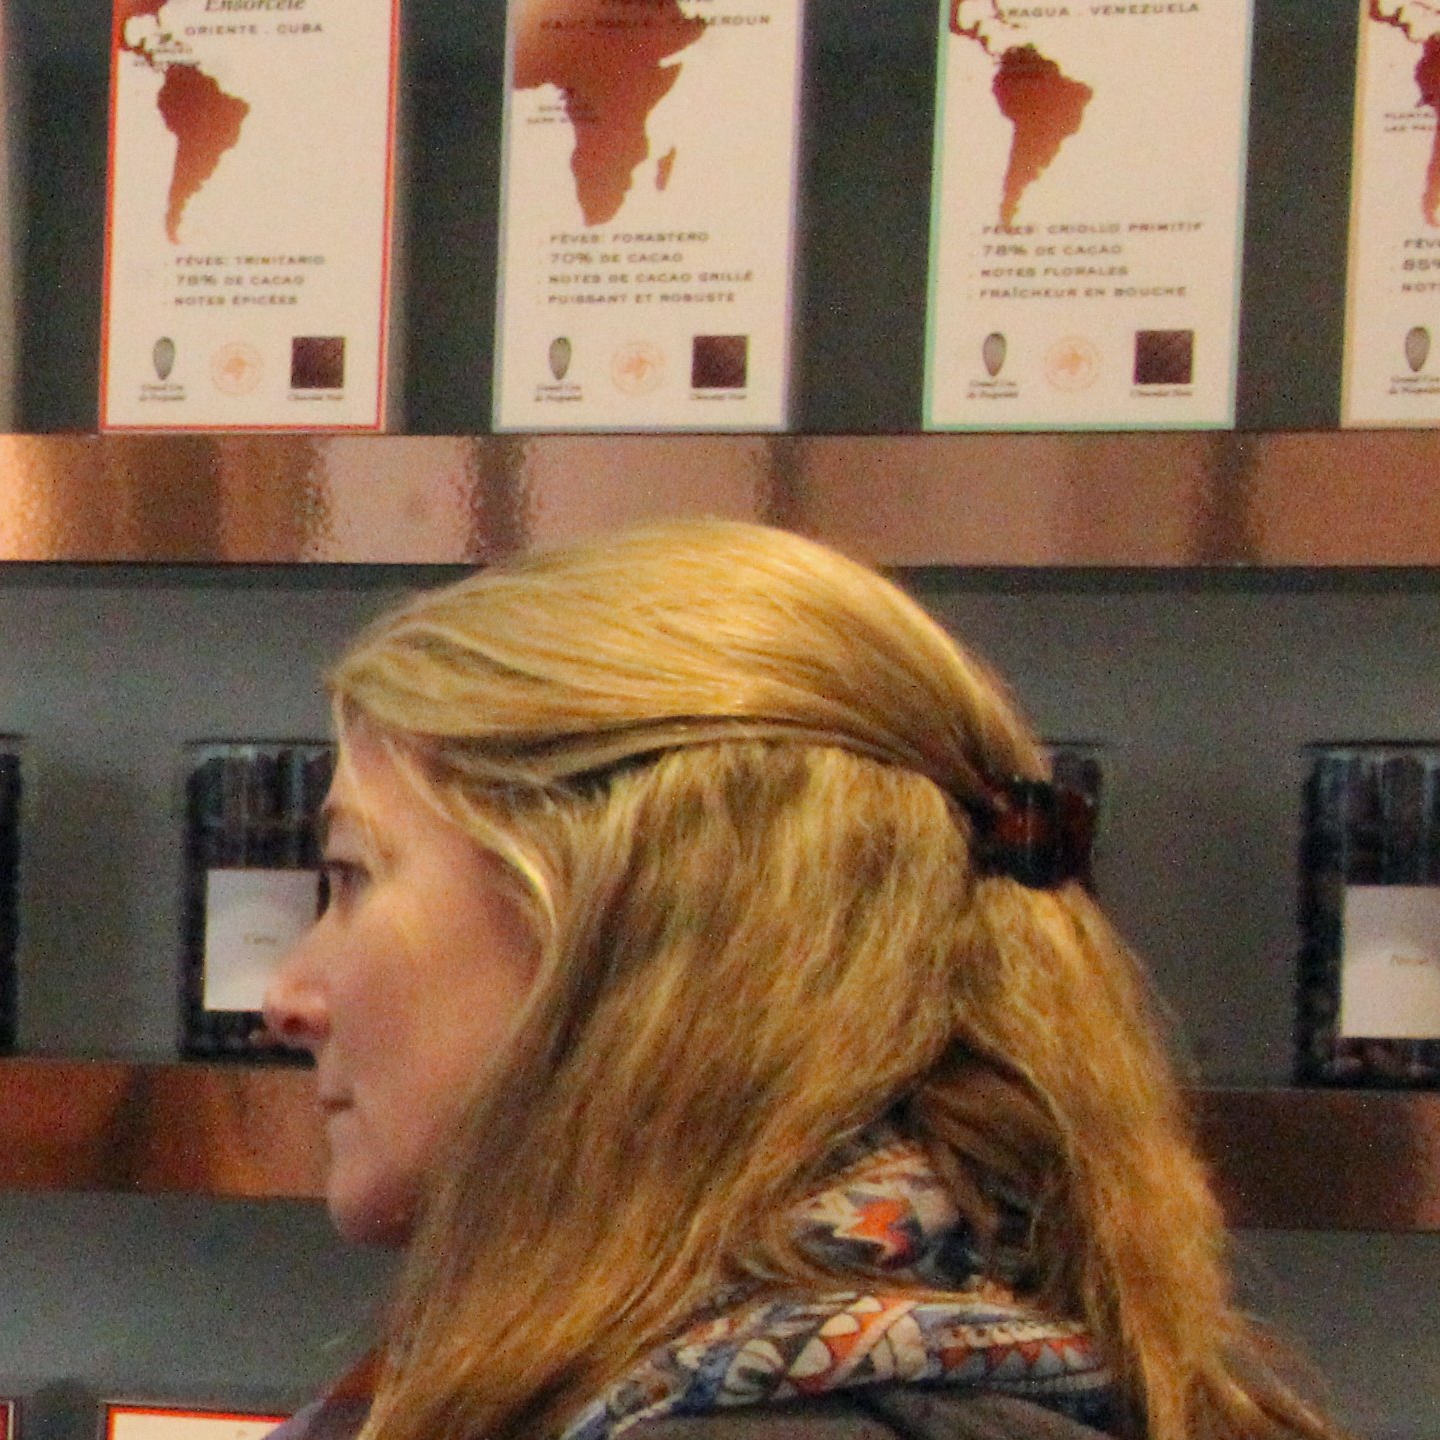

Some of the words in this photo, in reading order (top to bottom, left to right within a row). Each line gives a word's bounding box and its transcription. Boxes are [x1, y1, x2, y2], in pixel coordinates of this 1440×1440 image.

[998, 6, 1071, 18] ARAGUA
[1089, 2, 1200, 16] VENEZUELA
[185, 24, 259, 36] ORIENTE
[276, 22, 324, 35] CUBA
[1047, 223, 1121, 234] CRIOLLO
[1128, 222, 1204, 233] PRIMITIF
[612, 231, 710, 242] FORASTERO
[1034, 246, 1056, 256] DE
[1062, 245, 1123, 256] CACAO
[235, 254, 326, 265] TRINITARIO
[599, 253, 621, 263] DE
[627, 252, 684, 263] CACAO
[548, 274, 602, 284] NOTES
[608, 273, 629, 283] DE
[635, 272, 692, 283] CACAO
[698, 270, 754, 283] GRILLÉ
[980, 268, 1037, 278] NOTES
[1042, 266, 1129, 277] FLORALES
[224, 275, 245, 286] DE
[250, 274, 306, 286] CACAO
[1084, 288, 1106, 298] EN
[1113, 286, 1188, 298] BOUCHE
[174, 296, 226, 306] NOTES
[547, 293, 628, 305] PUISSANT
[634, 292, 653, 304] ET
[659, 292, 736, 303] ROBUSTE
